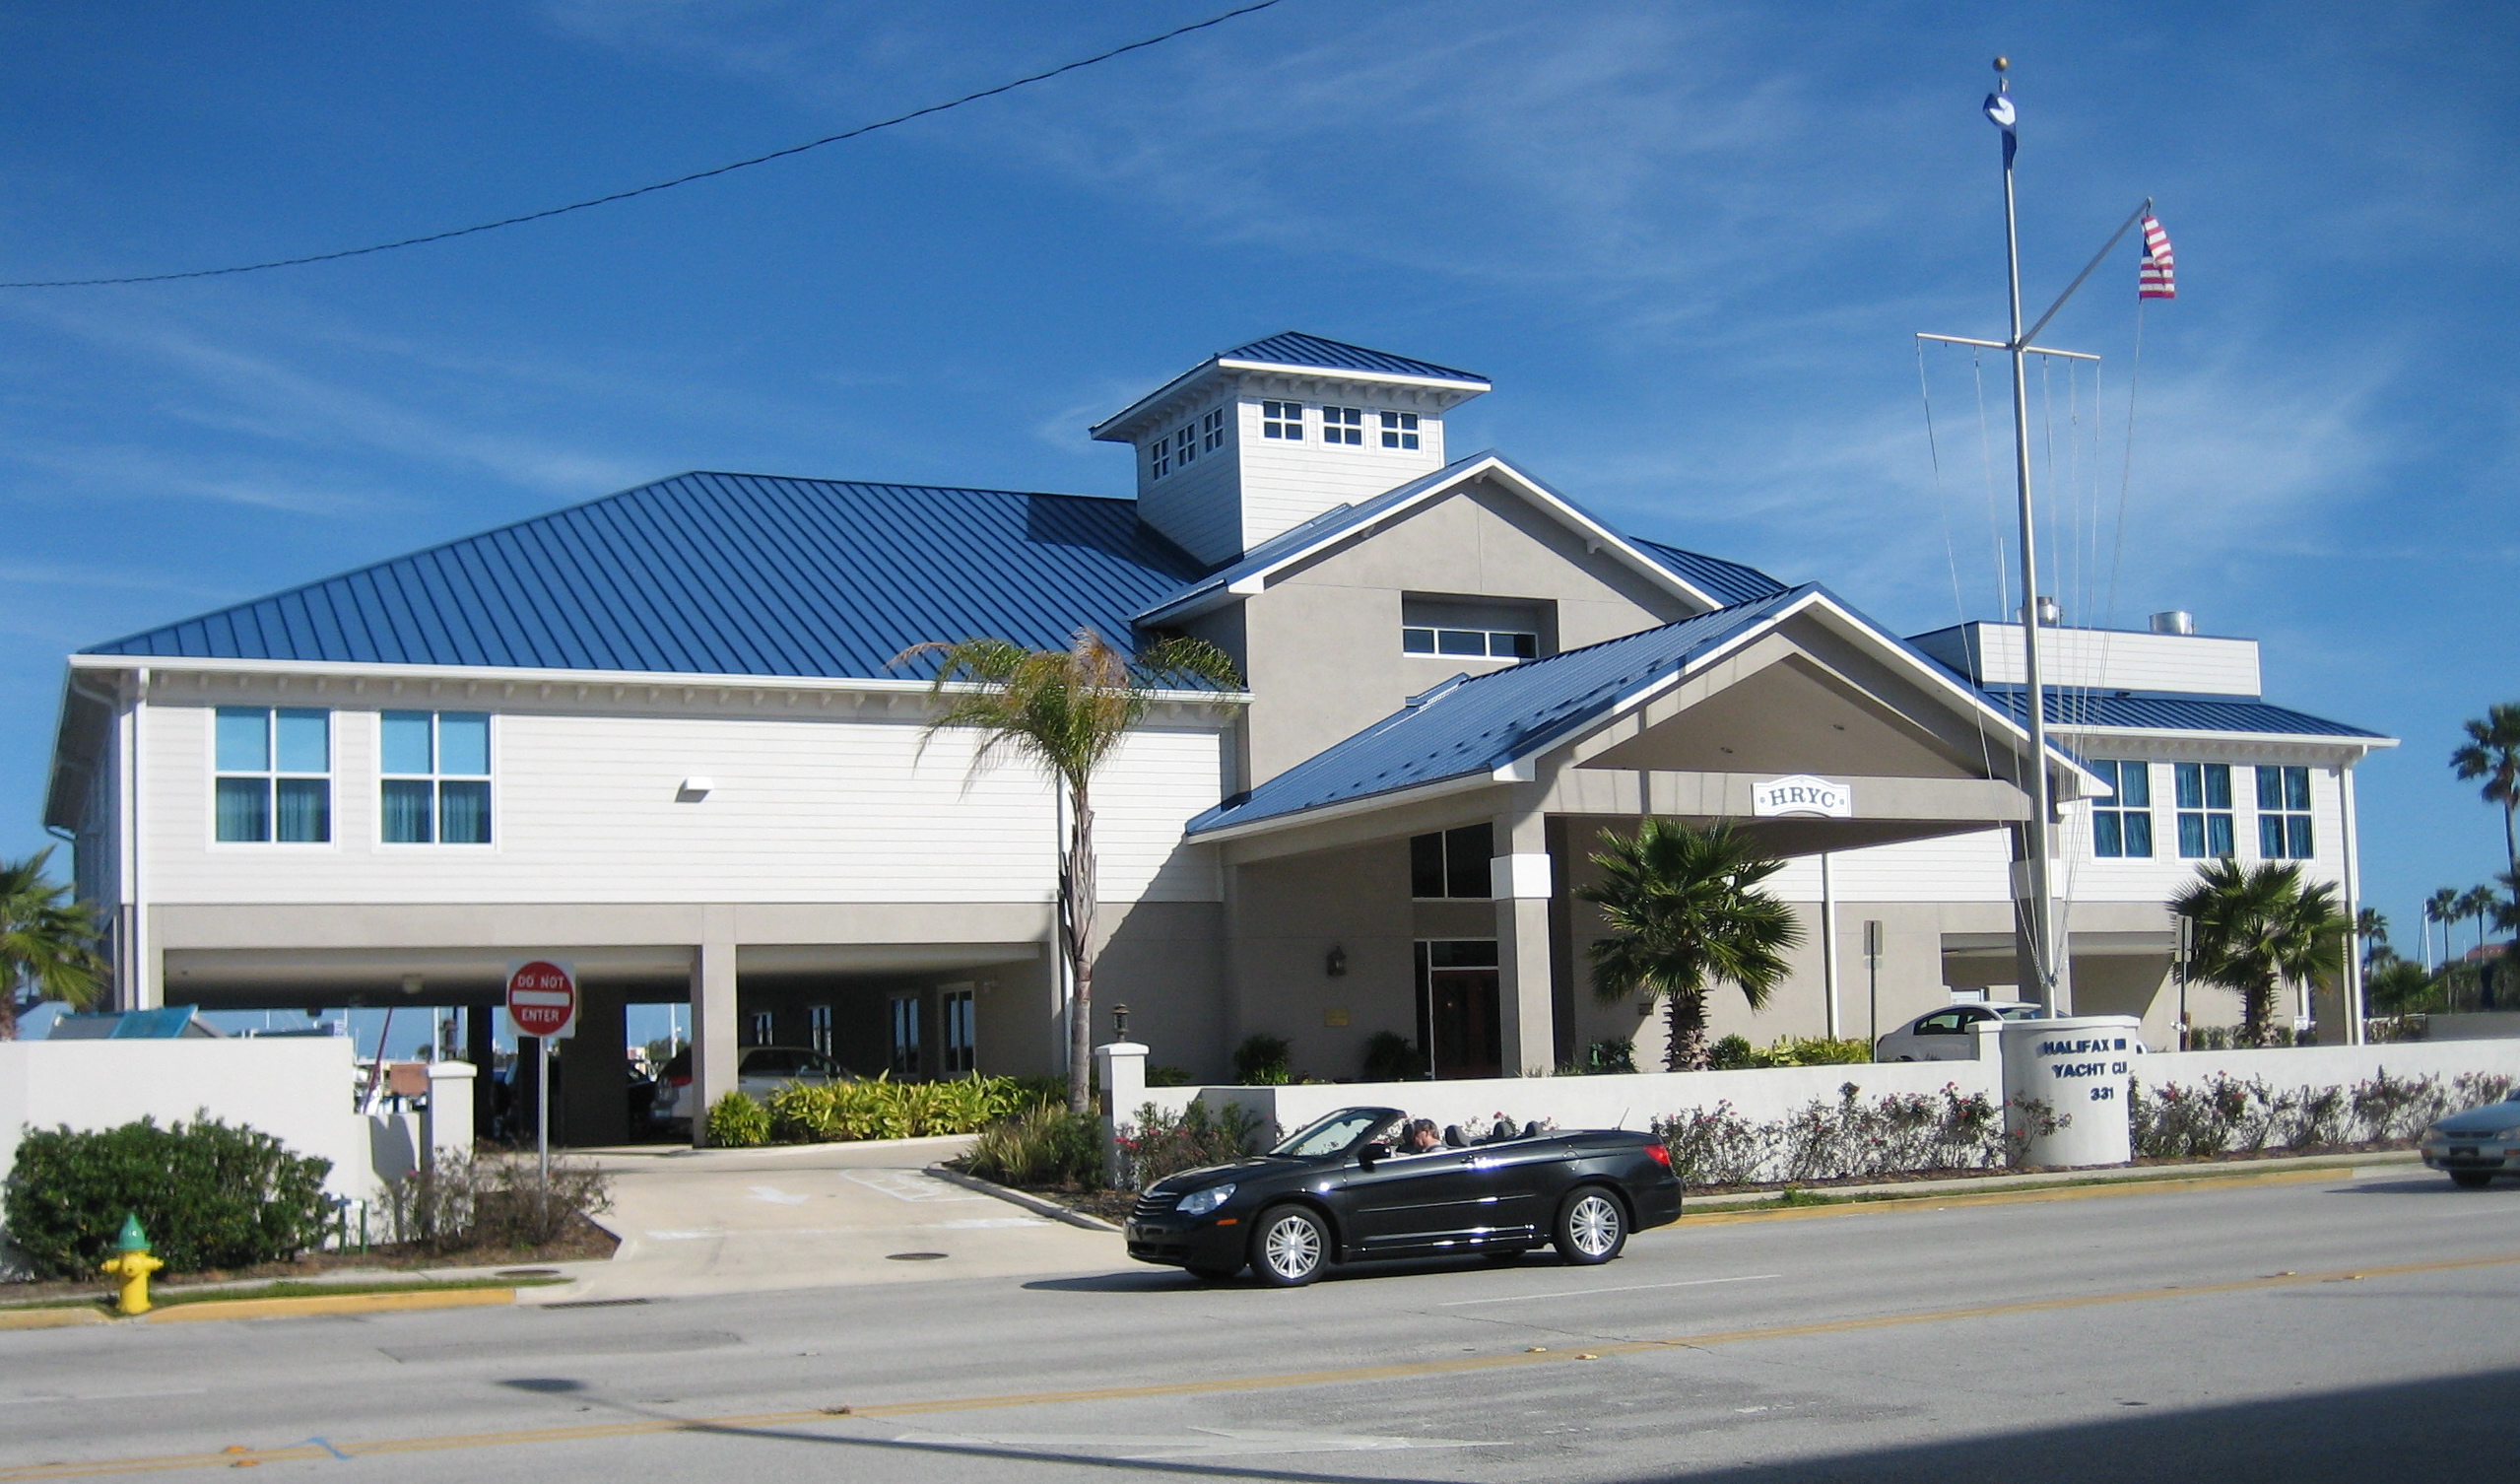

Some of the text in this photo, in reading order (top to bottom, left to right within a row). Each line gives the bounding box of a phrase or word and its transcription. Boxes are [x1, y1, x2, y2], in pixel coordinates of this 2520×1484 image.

[1768, 786, 1835, 808] HRYC
[517, 975, 564, 988] DO NOT
[522, 1008, 560, 1022] ENTER
[2042, 1039, 2110, 1055] HALIFAX
[2051, 1062, 2106, 1079] YACHT
[2089, 1086, 2114, 1101] 331
